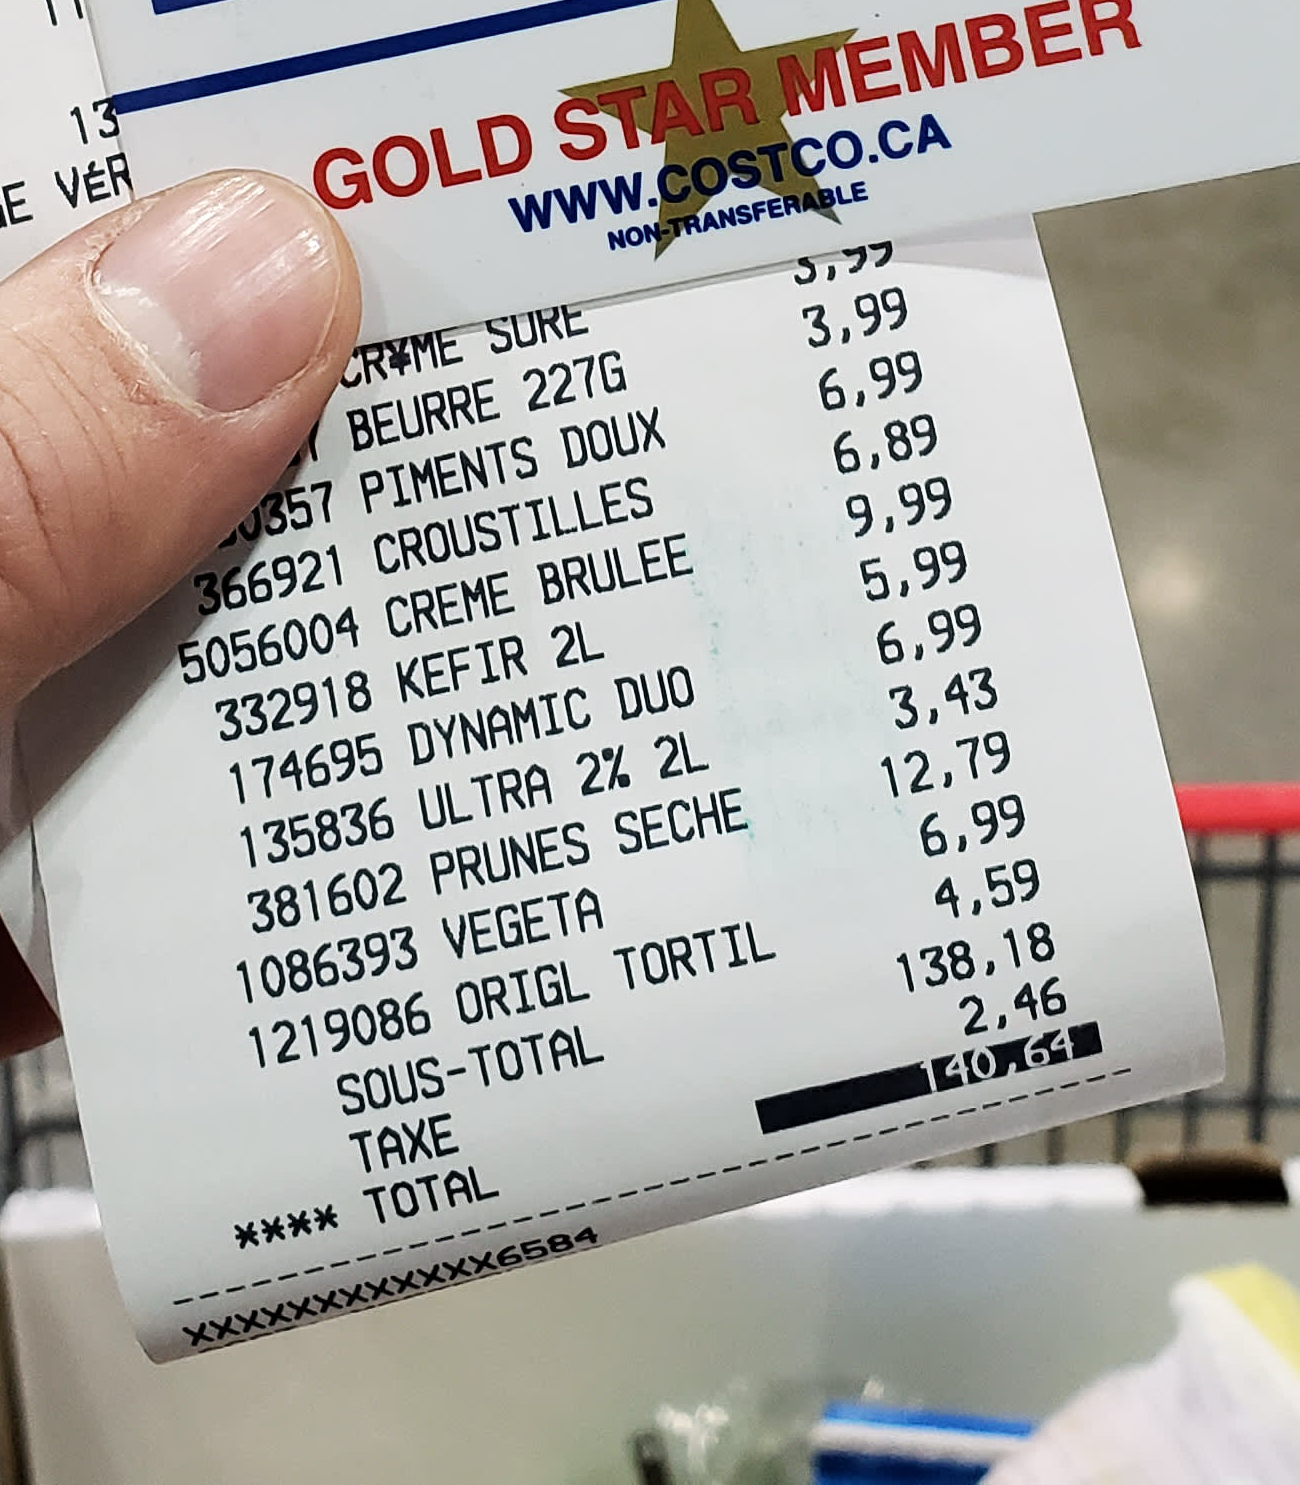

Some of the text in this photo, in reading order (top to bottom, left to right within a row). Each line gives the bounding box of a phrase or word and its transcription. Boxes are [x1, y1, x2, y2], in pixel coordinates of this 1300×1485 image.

[313, 114, 533, 210] GOLD
[554, 67, 760, 161] STAR
[508, 113, 952, 233] WWW.COSTCO.CA
[608, 181, 868, 250] NON-TRANSFERABLE
[346, 379, 500, 451] BEURRE
[523, 351, 626, 411] 227G
[802, 287, 907, 348] 3,99
[484, 304, 589, 354] SURE
[194, 414, 937, 616] 366921 CROUSTILLES 6,89
[360, 436, 538, 514] PIMENTS
[560, 407, 665, 468] DOUX
[819, 351, 922, 410] 6,99
[178, 477, 951, 684] 5056004 CREME BRULEE 9,99
[215, 541, 967, 741] 332918 KEFIR 2L 5,99
[230, 604, 981, 804] 174695 DYNAMIC DUO 6,99
[241, 667, 997, 868] 135836 ULTRA 2% 2L 3,43
[237, 795, 1025, 1003] 1086393 VEGETA 6,99
[248, 731, 1010, 933] 381602 PRUNES SECHE 12,79
[249, 859, 1039, 1068] 1219086 ORIGL TORTIL 4,59
[337, 922, 1054, 1116] SOUS-TOTAL 138,18
[349, 977, 1066, 1173] TAXE 2,46
[363, 1166, 499, 1224] TOTAL
[920, 1028, 1075, 1093] 140,64
